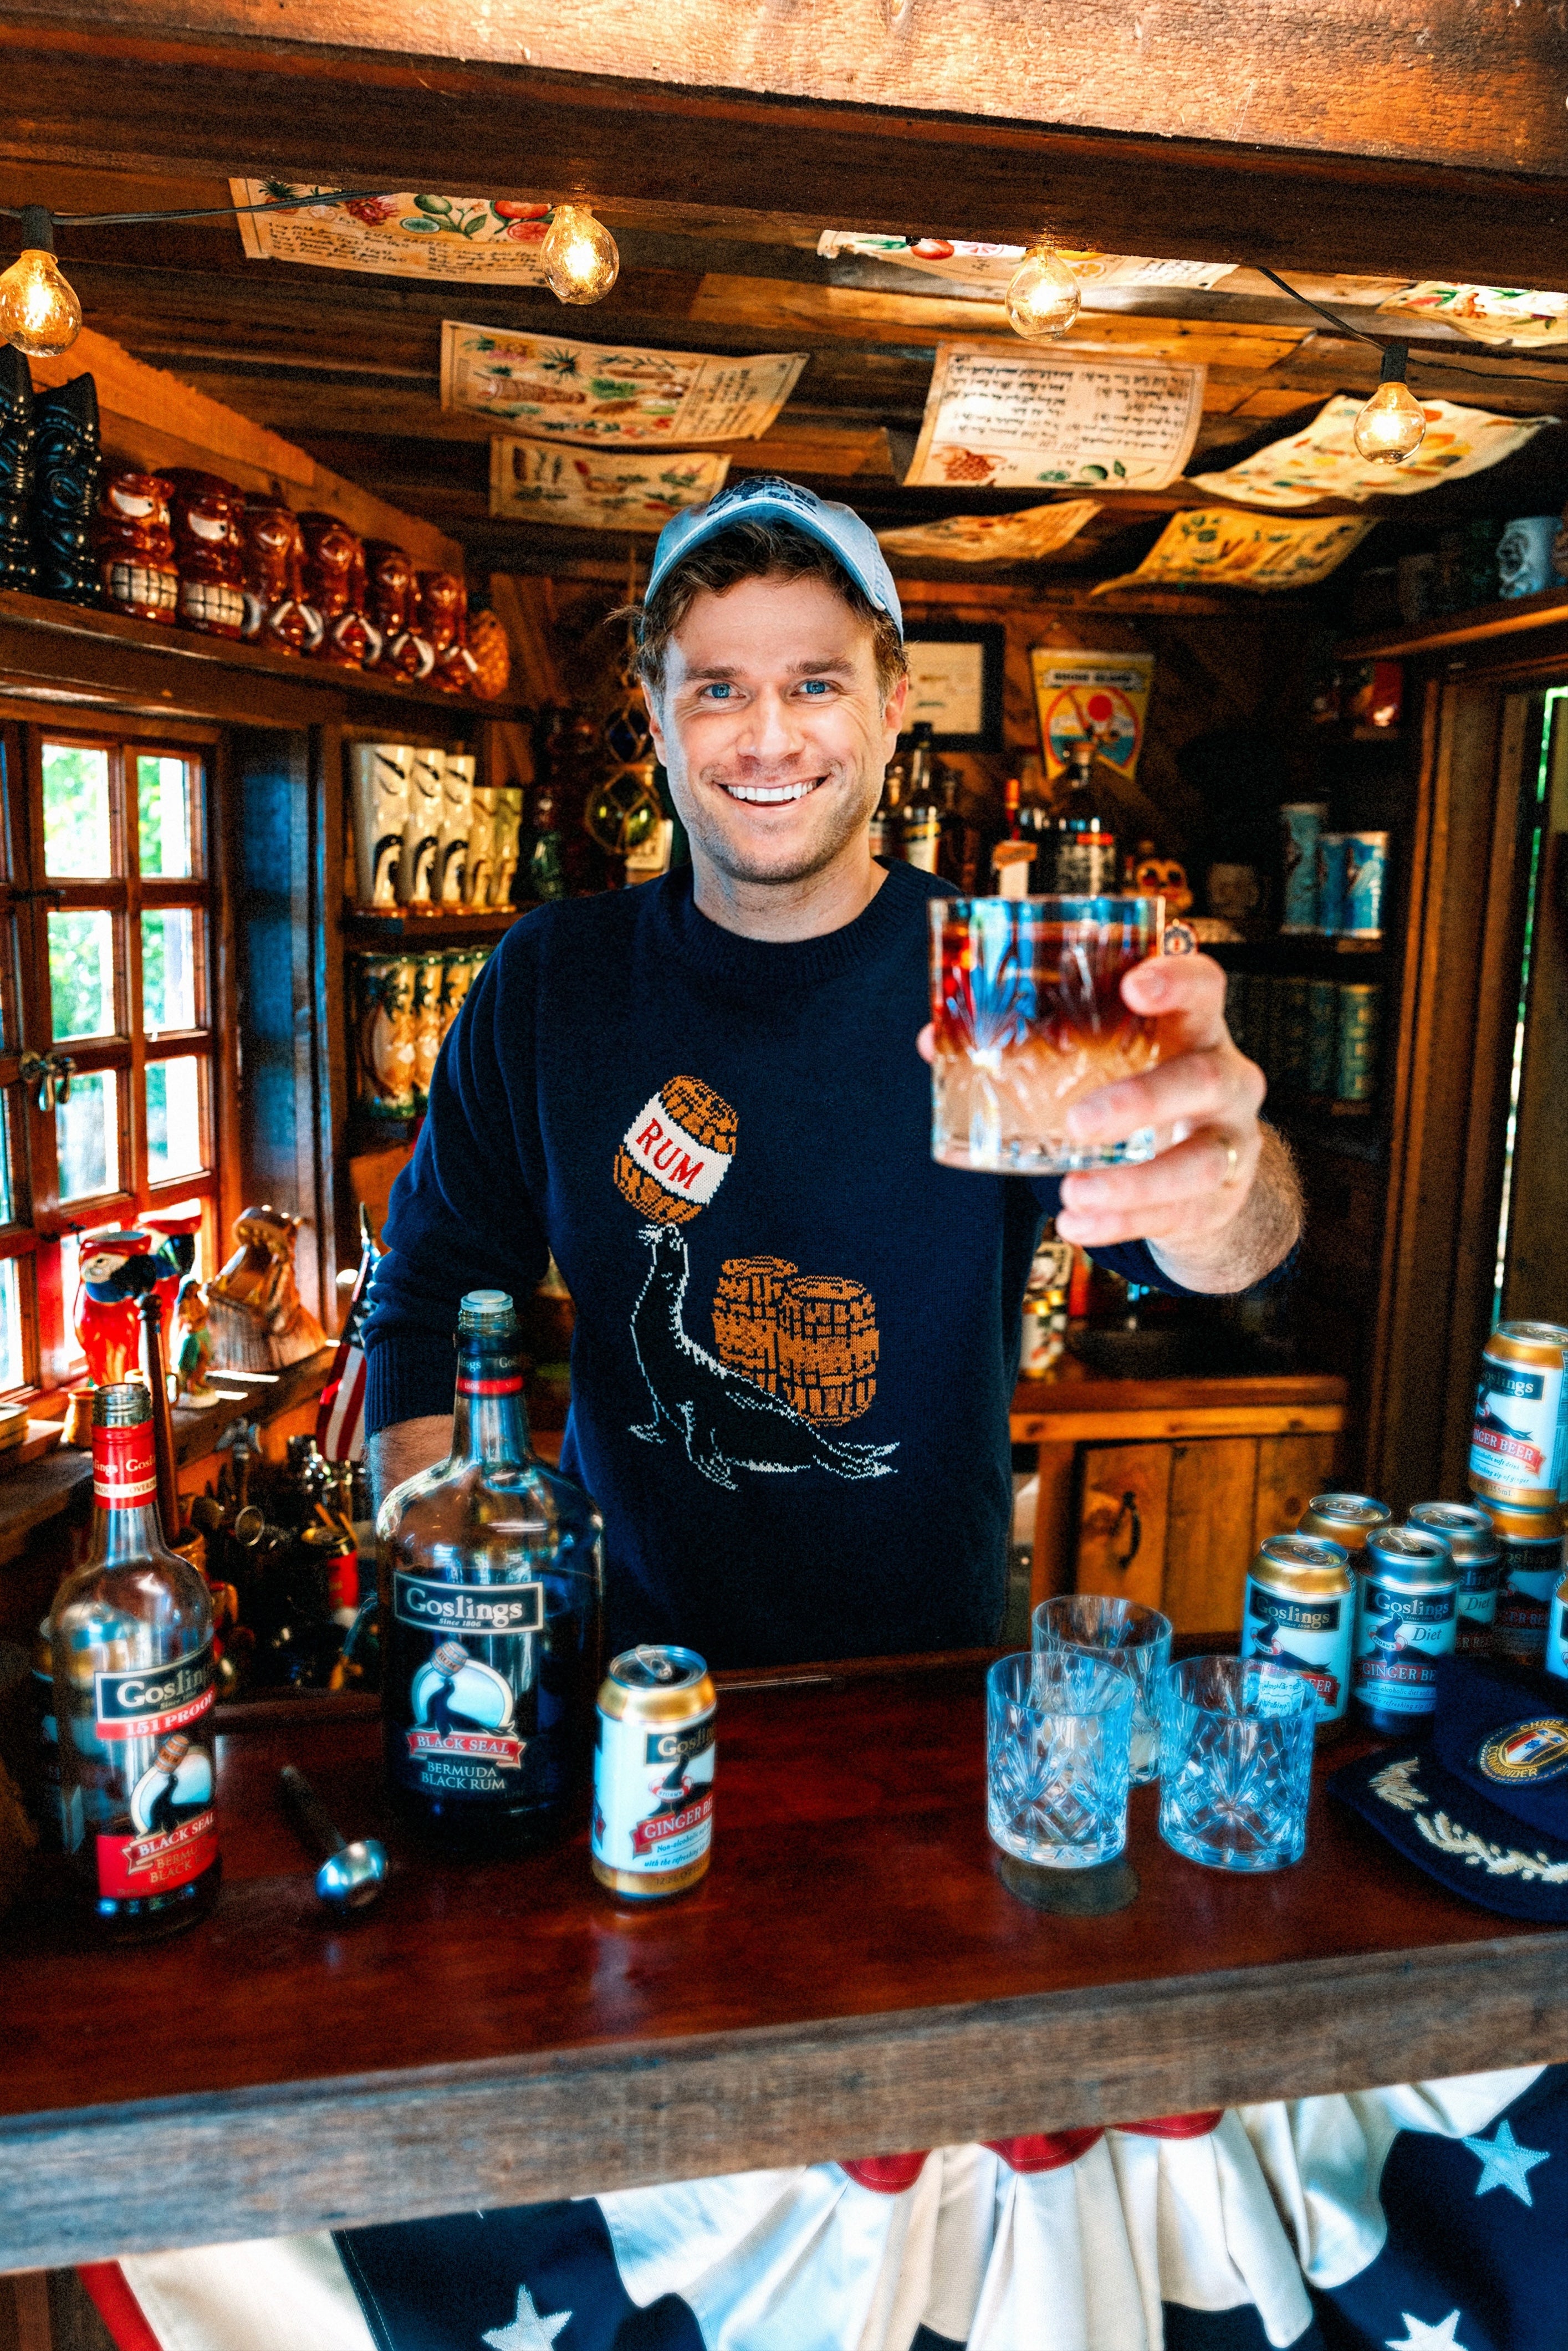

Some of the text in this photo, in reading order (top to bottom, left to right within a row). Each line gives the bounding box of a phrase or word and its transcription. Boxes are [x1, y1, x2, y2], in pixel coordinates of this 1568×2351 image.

[635, 1117, 704, 1189] RUM
[1484, 1371, 1534, 1397] oslings
[1473, 1428, 1534, 1461] NGER BEER
[1505, 1461, 1519, 1470] drink
[406, 1587, 523, 1628] Goslings
[1256, 1596, 1330, 1629] Goslings
[1375, 1593, 1449, 1619] Goslings
[1465, 1597, 1490, 1611] Diet
[438, 1618, 459, 1626] Since
[1411, 1627, 1442, 1642] Diet
[438, 1651, 459, 1670] RUM
[1362, 1663, 1437, 1681] GINGER BE
[117, 1668, 207, 1708] Goslin
[1309, 1678, 1331, 1693] EER
[1367, 1683, 1407, 1694] Non-alcoholic
[1383, 1700, 1413, 1710] refreshing
[126, 1718, 161, 1736] 151
[1520, 1720, 1564, 1731] CHRIS
[417, 1736, 509, 1754] BLACK SEAL
[658, 1725, 714, 1756] Goslin
[427, 1761, 497, 1778] BERMUDA
[1487, 1746, 1538, 1778] COMMANDER
[421, 1772, 506, 1790] BLACK RUM
[645, 1795, 713, 1838] GINGER BE
[139, 1828, 189, 1857] BLACK
[191, 1812, 214, 1836] SEAL
[657, 1832, 698, 1853] Non-alcoholic
[157, 1843, 200, 1869] BERMU
[645, 1859, 658, 1867] with
[150, 1861, 192, 1883] BLACK
